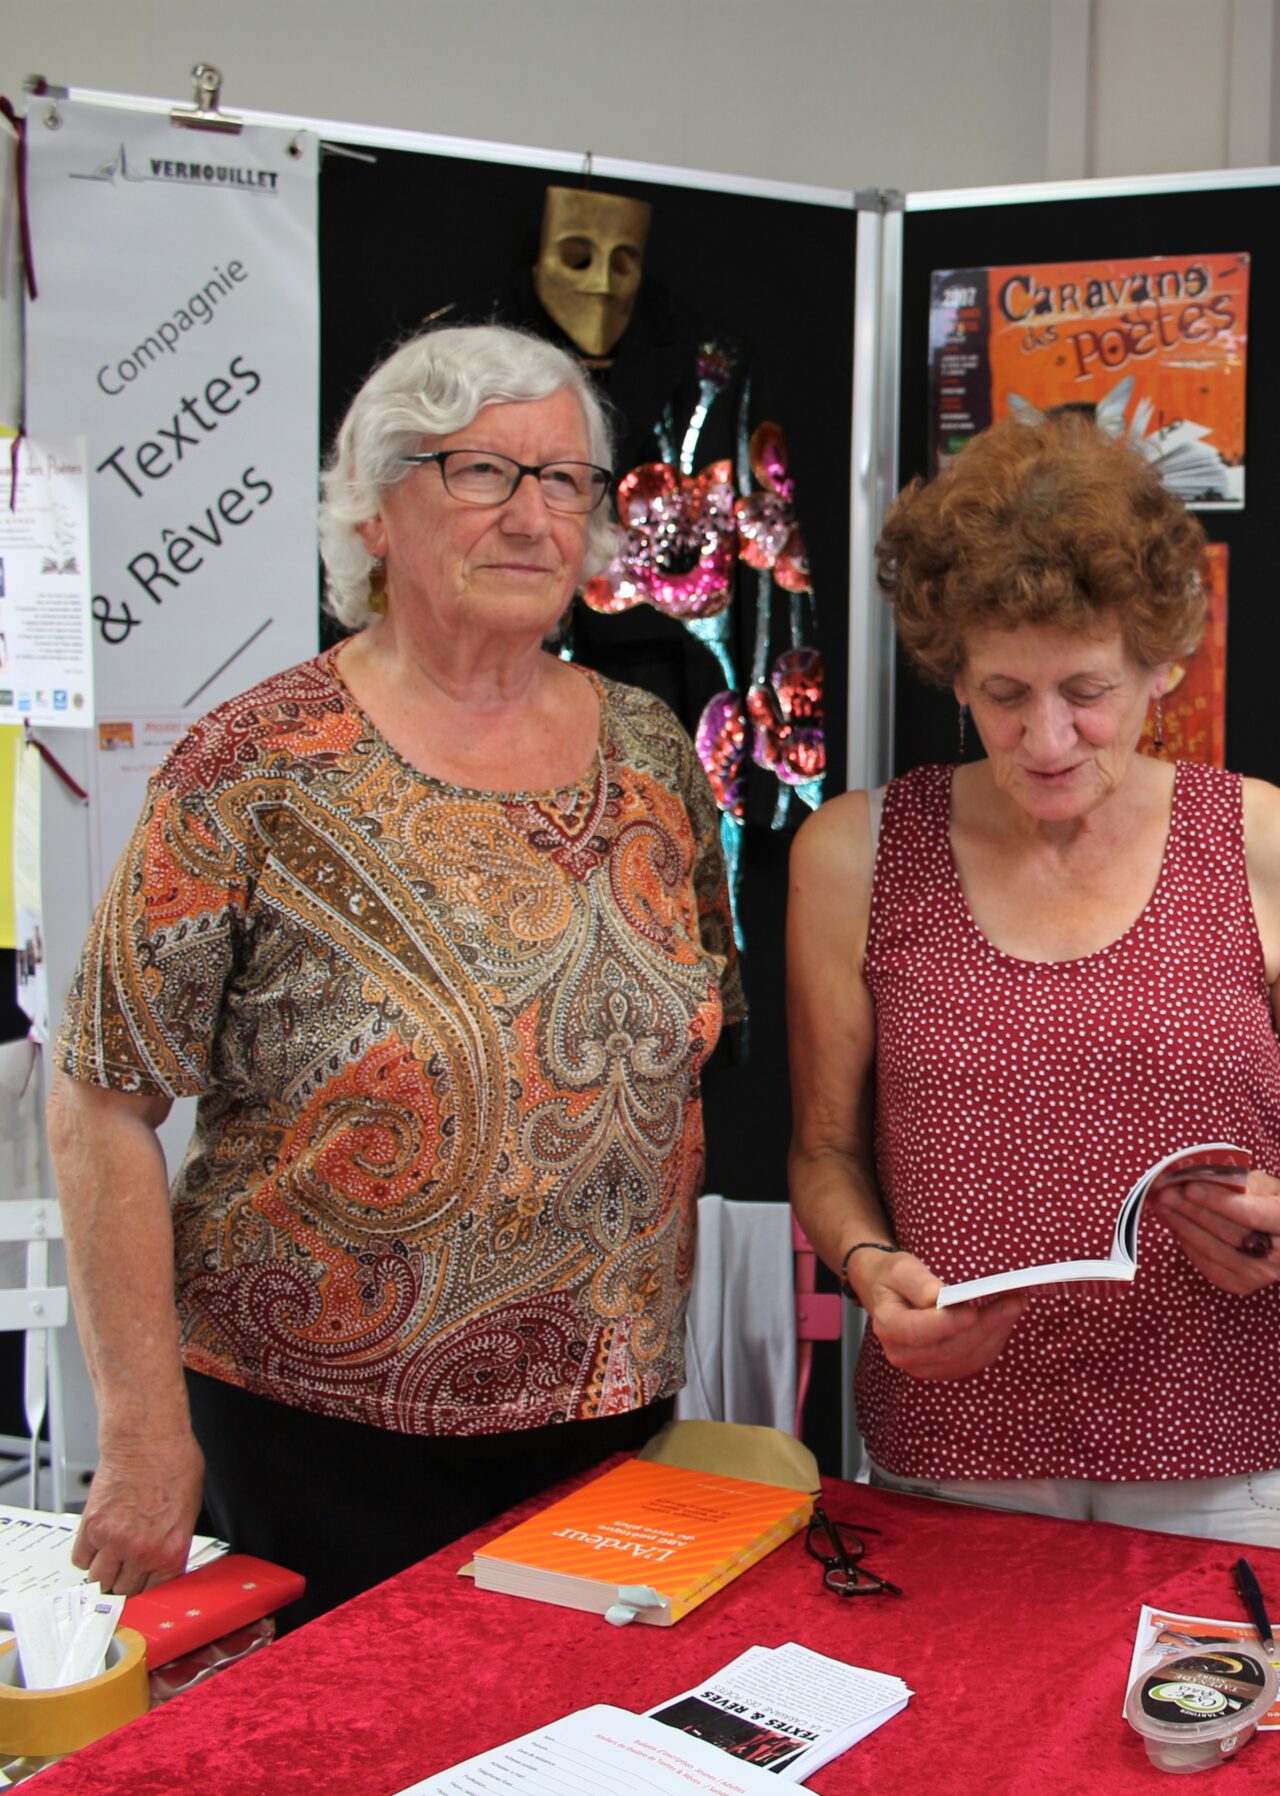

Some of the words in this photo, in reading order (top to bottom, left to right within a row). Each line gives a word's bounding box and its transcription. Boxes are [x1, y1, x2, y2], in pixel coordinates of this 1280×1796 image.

[150, 158, 279, 189] VERNOUILLET
[97, 257, 249, 397] Compagnie
[96, 356, 261, 498] Textes
[91, 595, 142, 645] &
[127, 466, 273, 605] Rêves
[553, 1527, 677, 1563] L'Ardeur
[657, 1537, 688, 1548] ABC
[1175, 1674, 1239, 1693] TAPENADE
[700, 1690, 749, 1714] RÊVES
[750, 1711, 766, 1720] &
[765, 1718, 820, 1741] TEXTES
